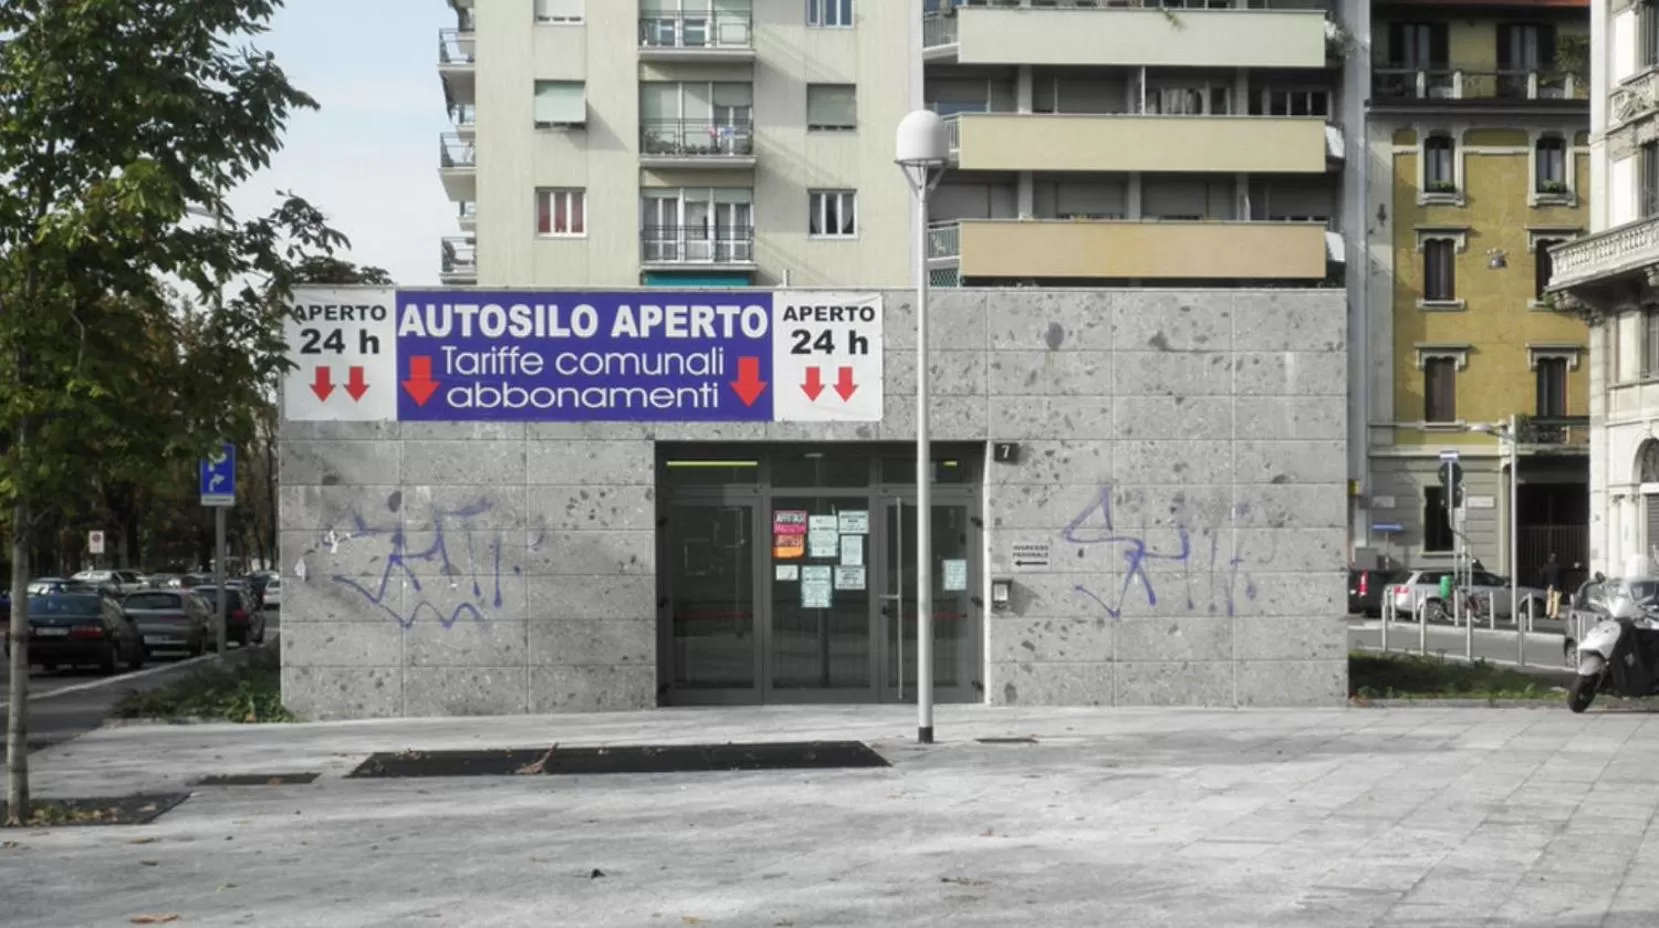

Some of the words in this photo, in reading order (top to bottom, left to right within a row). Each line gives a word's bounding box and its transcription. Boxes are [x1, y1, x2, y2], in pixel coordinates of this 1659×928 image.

[292, 305, 387, 321] APERTO
[398, 304, 599, 338] AUTOSILO
[611, 304, 768, 338] APERTO
[783, 306, 876, 322] APERTO
[300, 328, 346, 354] 24
[359, 328, 380, 354] h
[790, 329, 835, 355] 24
[849, 330, 869, 355] h
[441, 345, 544, 375] Tariffe
[555, 346, 724, 375] comunali
[447, 381, 719, 408] abbonamenti
[1001, 445, 1010, 459] 7
